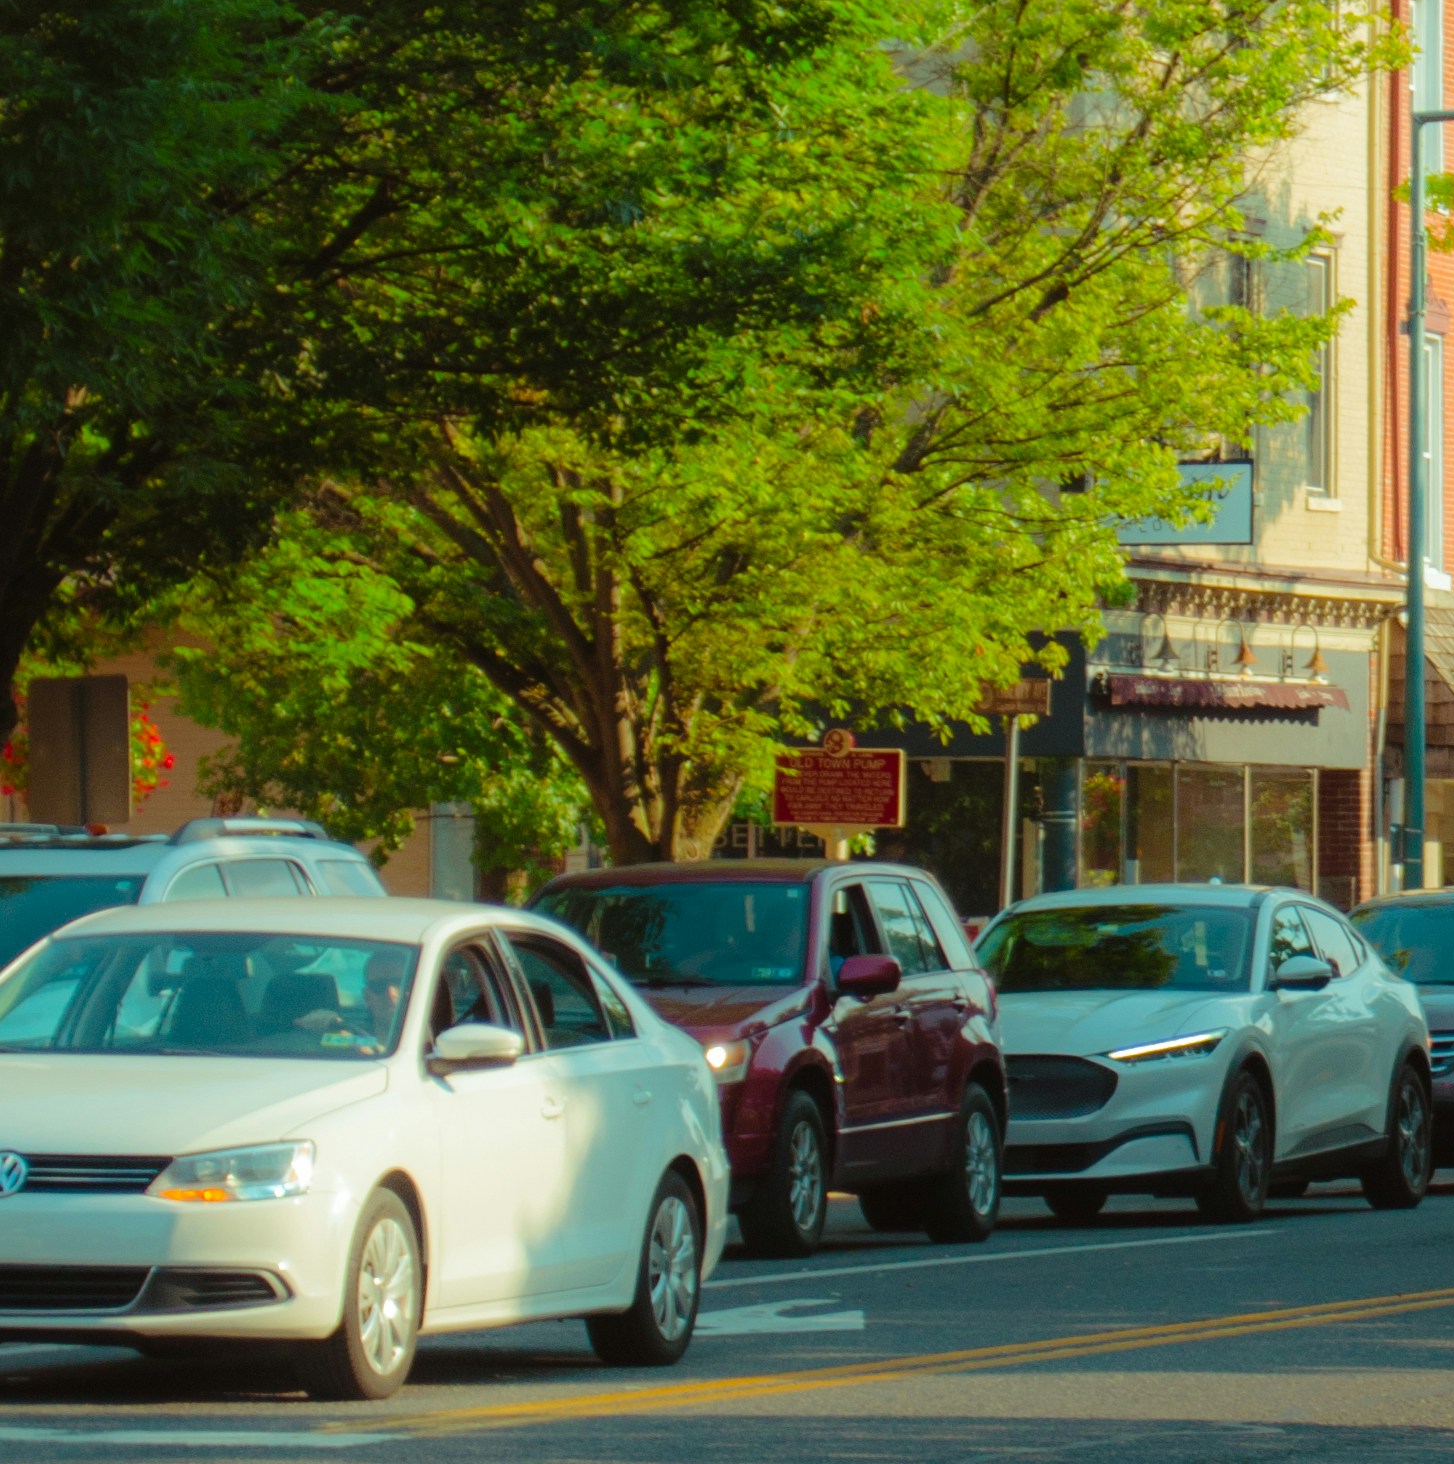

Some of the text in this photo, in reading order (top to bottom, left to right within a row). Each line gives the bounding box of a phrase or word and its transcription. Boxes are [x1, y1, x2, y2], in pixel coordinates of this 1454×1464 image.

[789, 758, 887, 770] OLD TOWN PUMP
